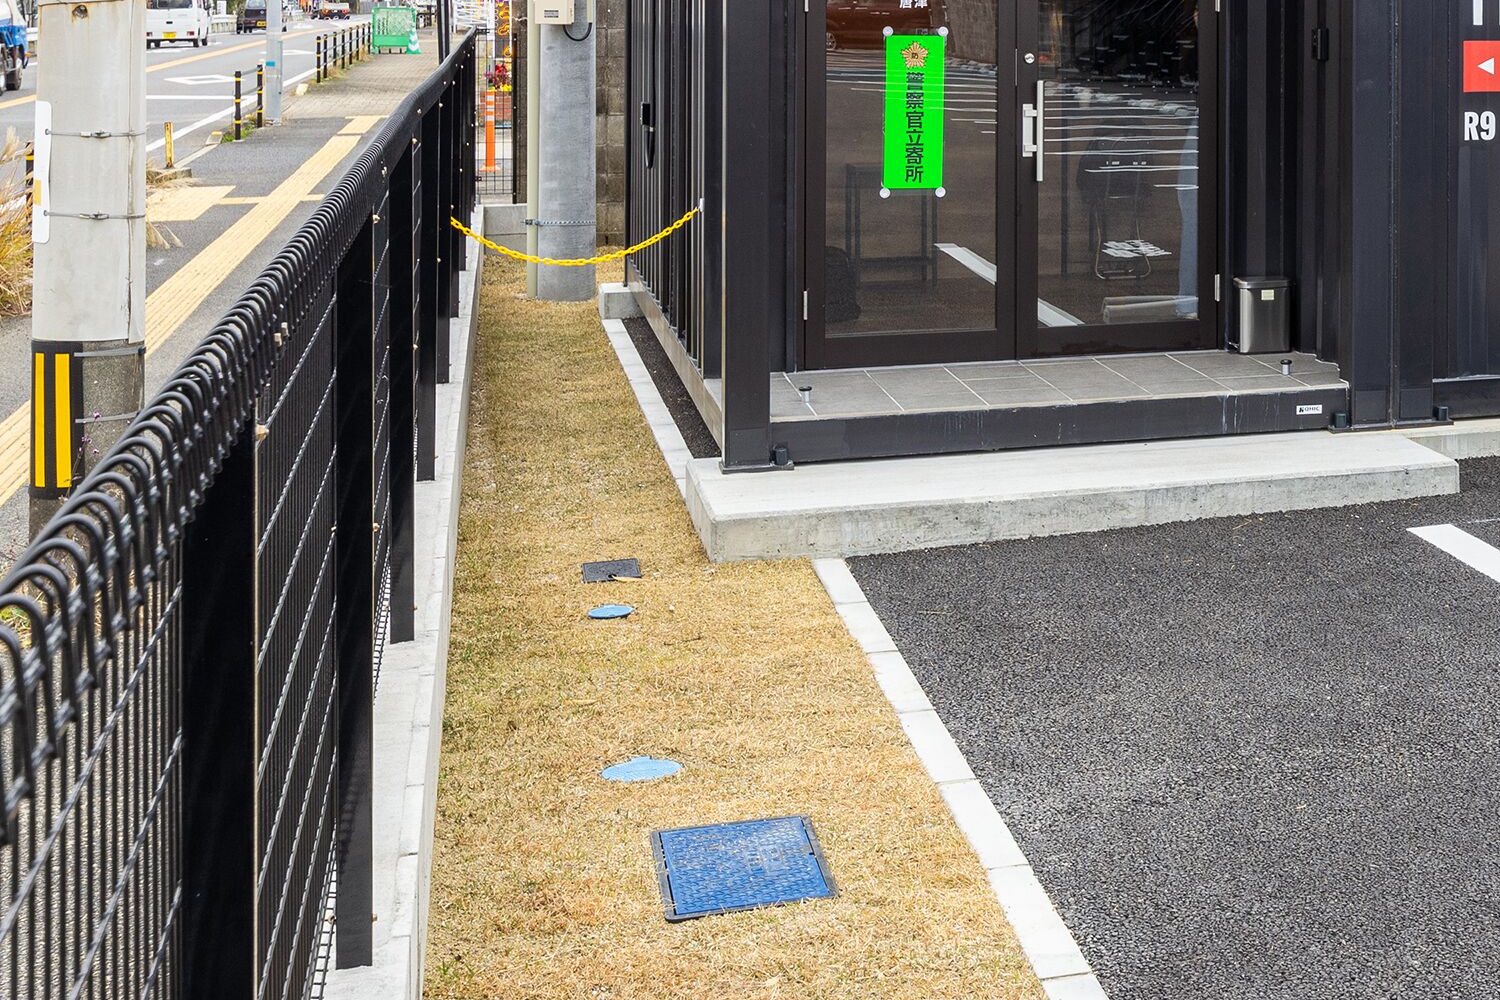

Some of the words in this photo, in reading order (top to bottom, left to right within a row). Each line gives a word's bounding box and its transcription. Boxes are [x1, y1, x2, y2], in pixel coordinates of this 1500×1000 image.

[905, 71, 924, 183] 警察官立寄所
[1464, 111, 1496, 140] R9
